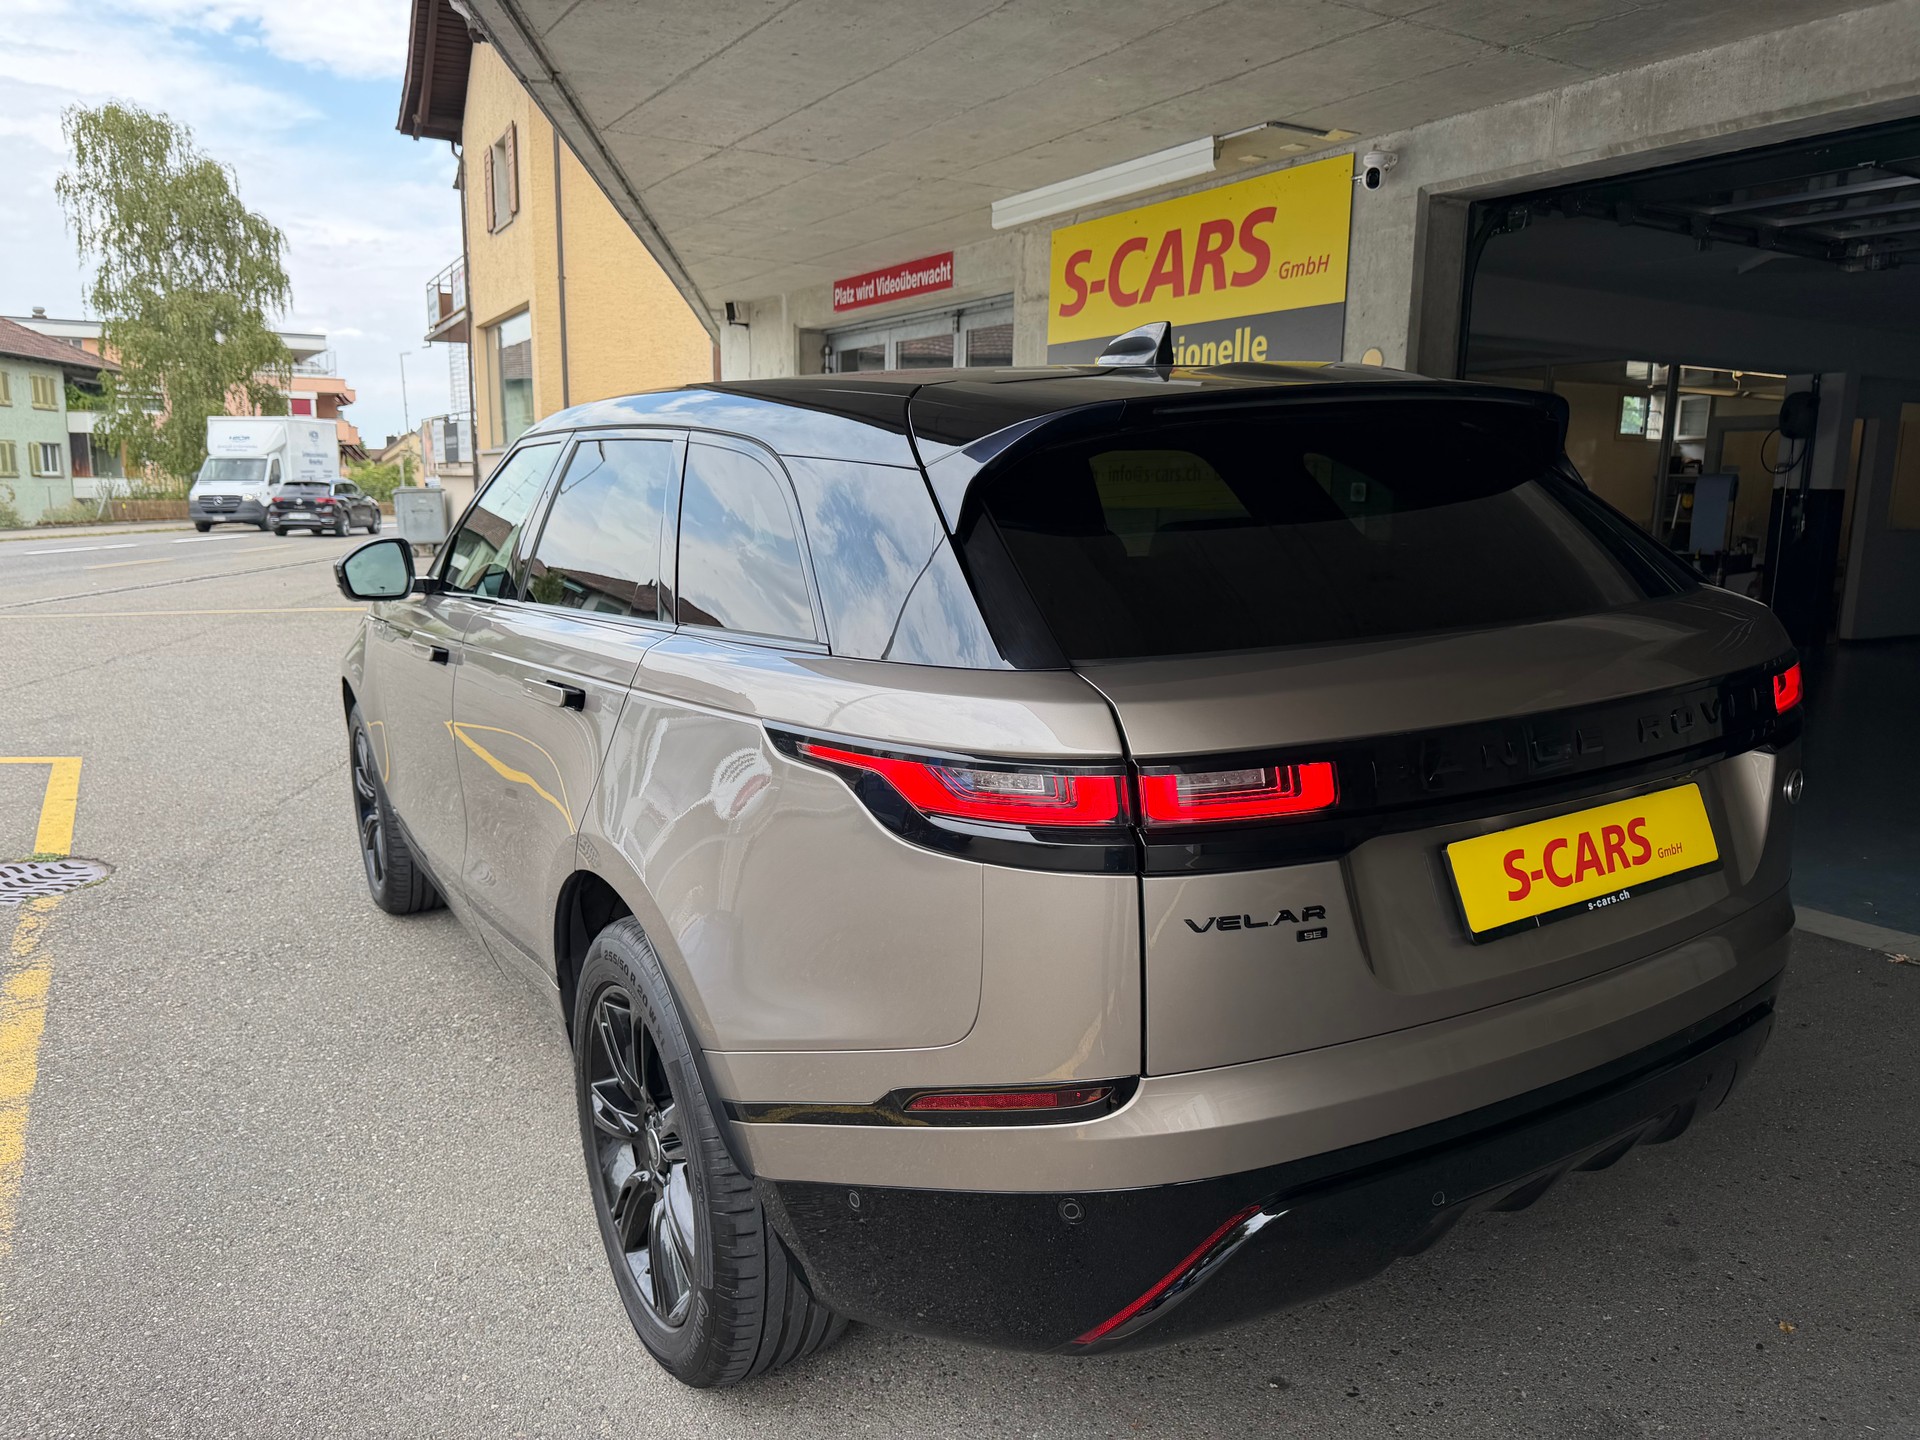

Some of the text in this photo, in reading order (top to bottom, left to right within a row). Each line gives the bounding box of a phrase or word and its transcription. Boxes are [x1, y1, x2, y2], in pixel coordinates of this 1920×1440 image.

[834, 261, 952, 306] Platz wird Videoüberwacht
[1058, 206, 1331, 318] S-CARS GmbH
[1502, 816, 1683, 902] S-CARS GmbH
[1184, 904, 1327, 934] VELAR
[1587, 889, 1631, 911] s-cars.ch
[1304, 930, 1322, 940] SE
[603, 949, 629, 977] 255/50
[637, 984, 648, 1007] 20
